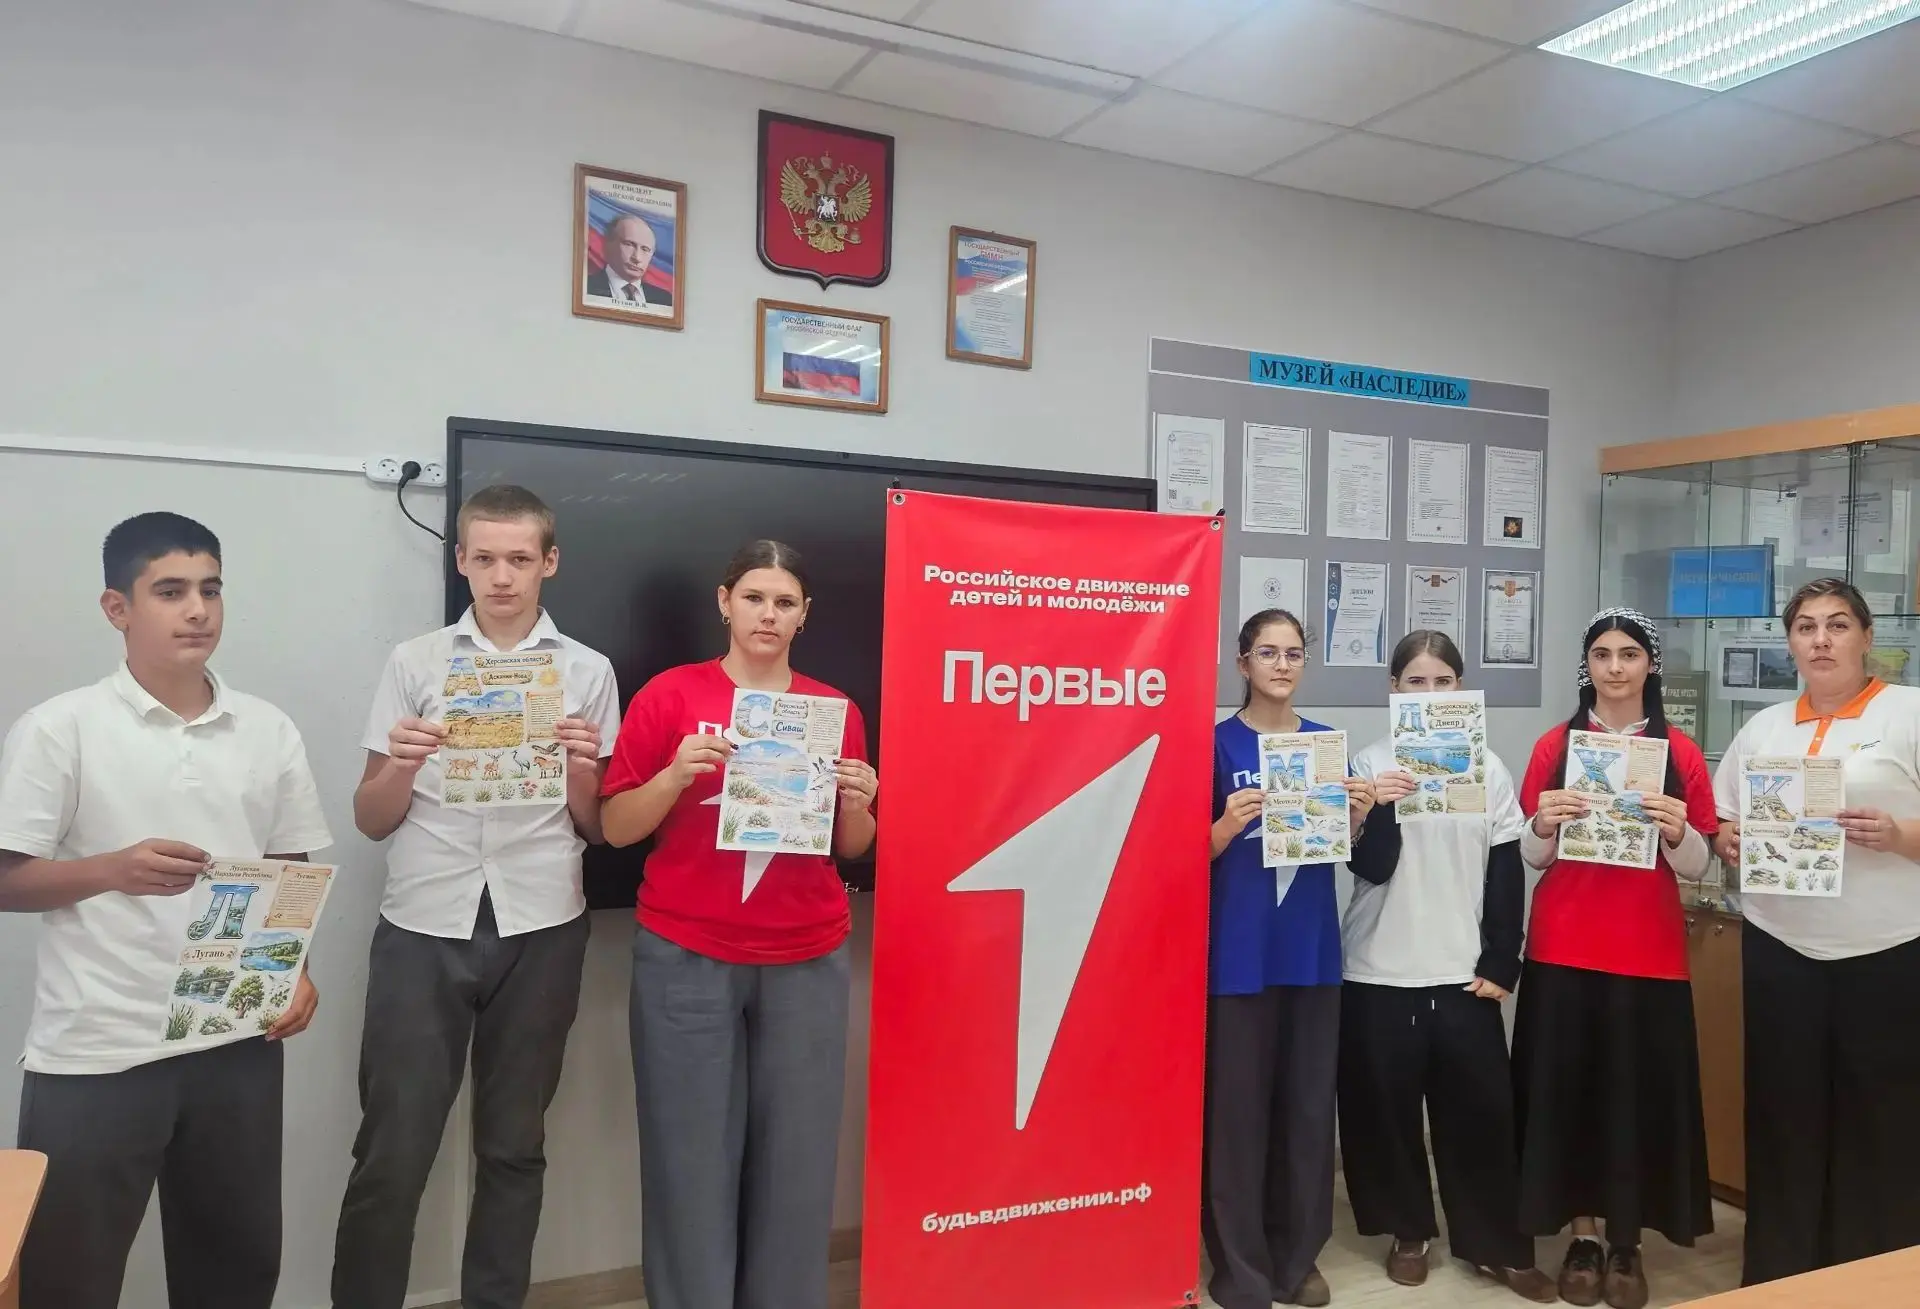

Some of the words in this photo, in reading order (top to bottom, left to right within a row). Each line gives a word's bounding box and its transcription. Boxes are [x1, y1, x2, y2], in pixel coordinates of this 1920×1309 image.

[612, 183, 653, 196] ПРЕЗИДЕНТ
[781, 315, 845, 331] ГОСУДАРСТВЕННЫЙ
[845, 325, 863, 333] ФЛАГ
[1258, 358, 1335, 387] МУЗЕЙ
[1338, 370, 1467, 402] «НАСЛЕДИЕ»
[924, 565, 1072, 591] Российское
[1075, 578, 1190, 597] движение
[950, 588, 1023, 607] детей
[1027, 594, 1042, 608] и
[1047, 592, 1166, 613] молодёжи
[485, 657, 521, 667] Херсонская
[522, 656, 546, 664] область
[943, 650, 1167, 722] Первые
[775, 721, 804, 733] Сиваш
[1435, 719, 1460, 728] Днепр
[191, 949, 226, 961] Лугань
[922, 1182, 1152, 1234] будьвдвижении.рф
